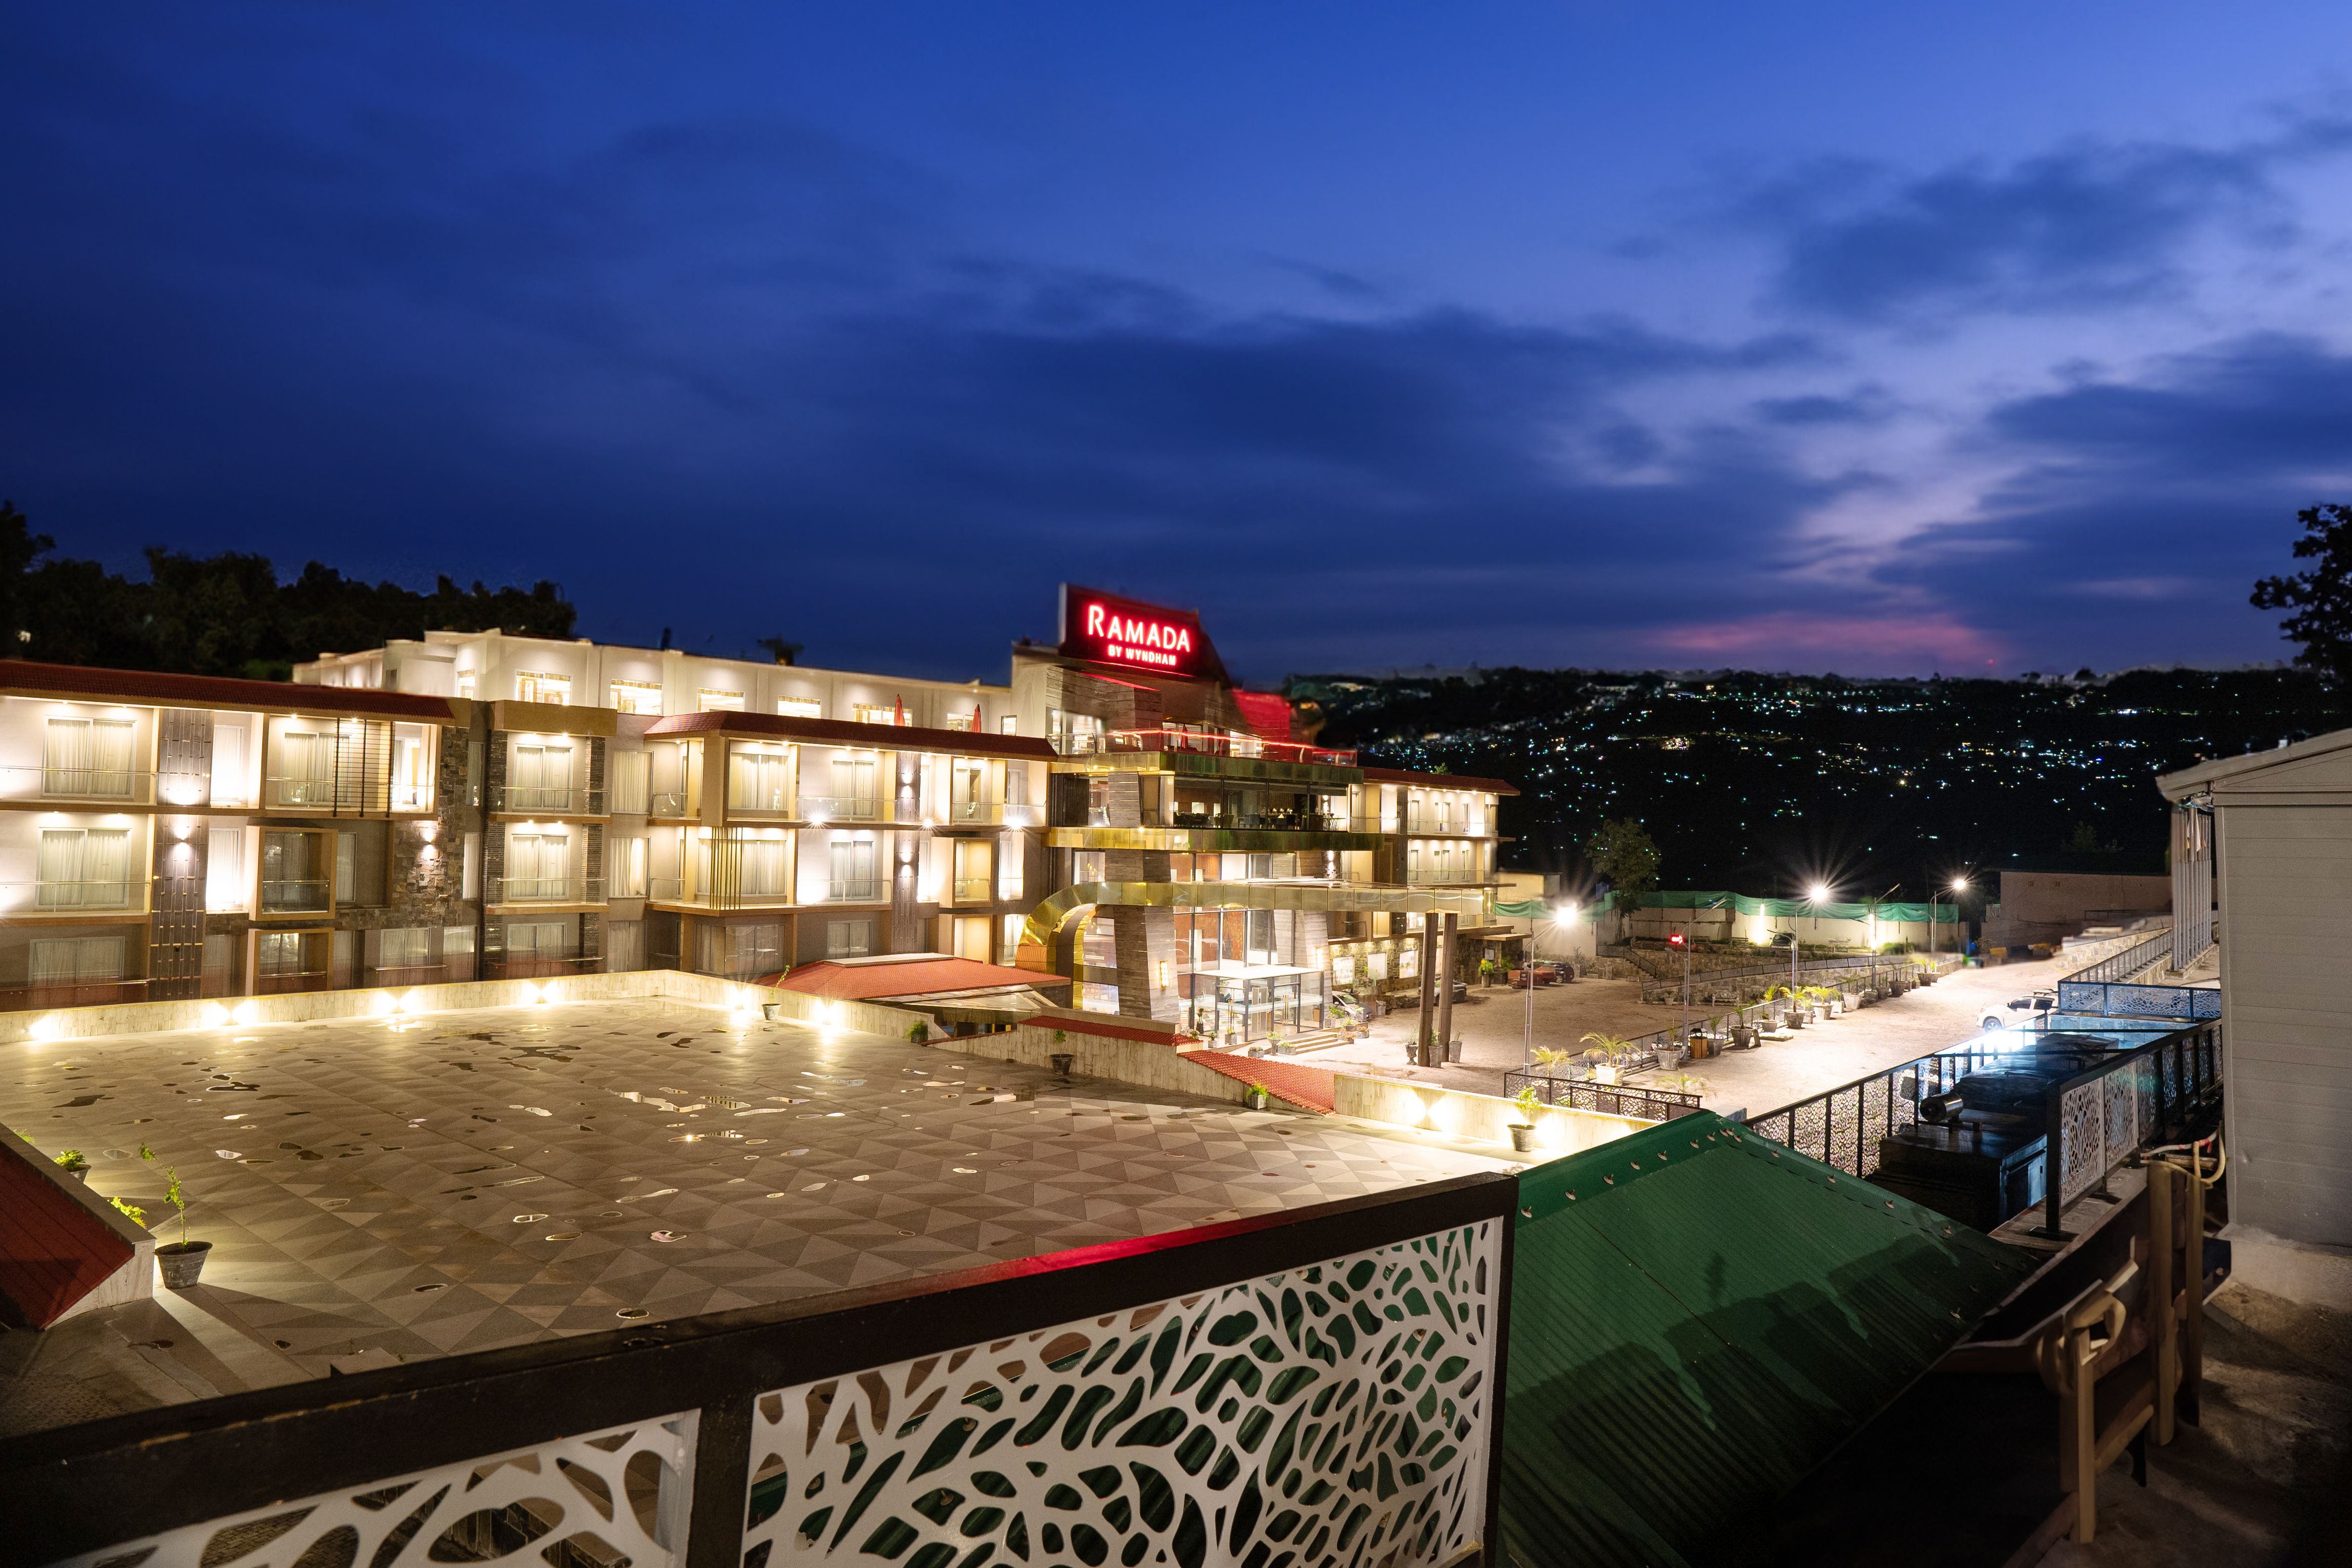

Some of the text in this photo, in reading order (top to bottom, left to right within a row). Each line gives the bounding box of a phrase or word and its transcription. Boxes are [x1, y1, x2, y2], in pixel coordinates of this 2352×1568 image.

[1088, 605, 1190, 652] RAMADA
[1108, 645, 1176, 666] BY WYNDHAM
